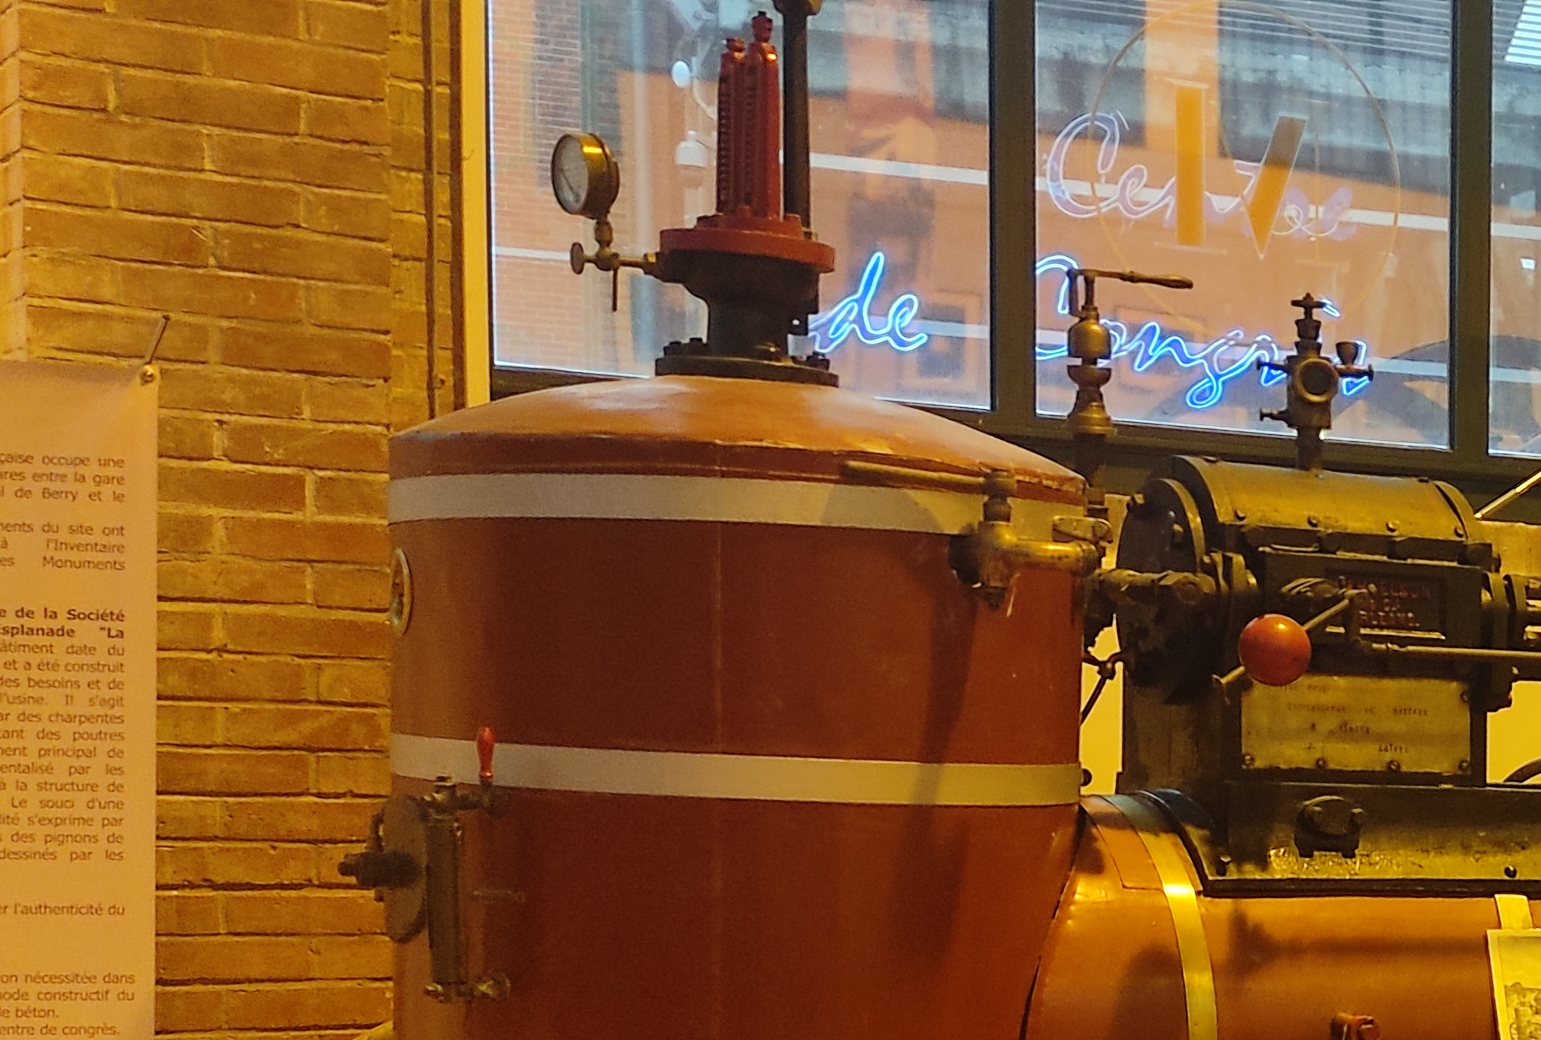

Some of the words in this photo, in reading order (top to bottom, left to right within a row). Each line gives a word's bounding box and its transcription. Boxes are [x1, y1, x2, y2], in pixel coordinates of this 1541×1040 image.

[42, 455, 90, 467] occupe
[98, 458, 125, 468] une
[32, 472, 68, 482] entre
[74, 472, 86, 484] la
[92, 474, 125, 487] gare
[14, 487, 32, 499] de
[42, 487, 78, 502] Berry
[88, 490, 102, 502] et
[112, 490, 125, 503] le
[41, 522, 60, 534] du
[68, 524, 94, 536] site
[102, 526, 125, 537] ont
[46, 538, 125, 554] l'Inventaire
[42, 555, 126, 571] Monuments
[15, 606, 35, 619] de
[44, 607, 58, 620] la
[66, 608, 125, 622] Société
[99, 627, 124, 639] "La
[66, 644, 97, 656] date
[107, 644, 125, 656] du
[3, 659, 18, 671] et
[37, 659, 60, 672] été
[64, 662, 125, 673] construit
[27, 676, 81, 689] besoins
[87, 679, 101, 690] et
[107, 678, 125, 690] de
[65, 694, 74, 706] Il
[88, 695, 124, 710] s'agit
[16, 711, 42, 723] des
[48, 712, 125, 726] charpentes
[36, 728, 61, 741] des
[72, 730, 125, 742] poutres
[38, 746, 97, 759] principal
[107, 747, 124, 759] de
[68, 765, 91, 777] par
[106, 764, 125, 776] les
[16, 780, 28, 792] la
[36, 781, 99, 792] structure
[107, 781, 124, 793] de
[11, 796, 28, 809] Le
[86, 798, 125, 810] d'une
[27, 814, 94, 828] s'exprime
[101, 817, 124, 829] par
[10, 831, 36, 843] des
[44, 834, 99, 846] pignons
[106, 832, 124, 844] de
[70, 851, 93, 862] par
[105, 849, 124, 862] les
[14, 903, 103, 916] l'authenticité
[107, 904, 126, 916] du
[24, 972, 97, 984] nécessitée
[102, 972, 135, 984] dans
[36, 989, 110, 1002] constructif
[116, 990, 135, 1001] du
[15, 1006, 60, 1018] béton.
[39, 1024, 57, 1036] de
[61, 1022, 120, 1038] congrès.
